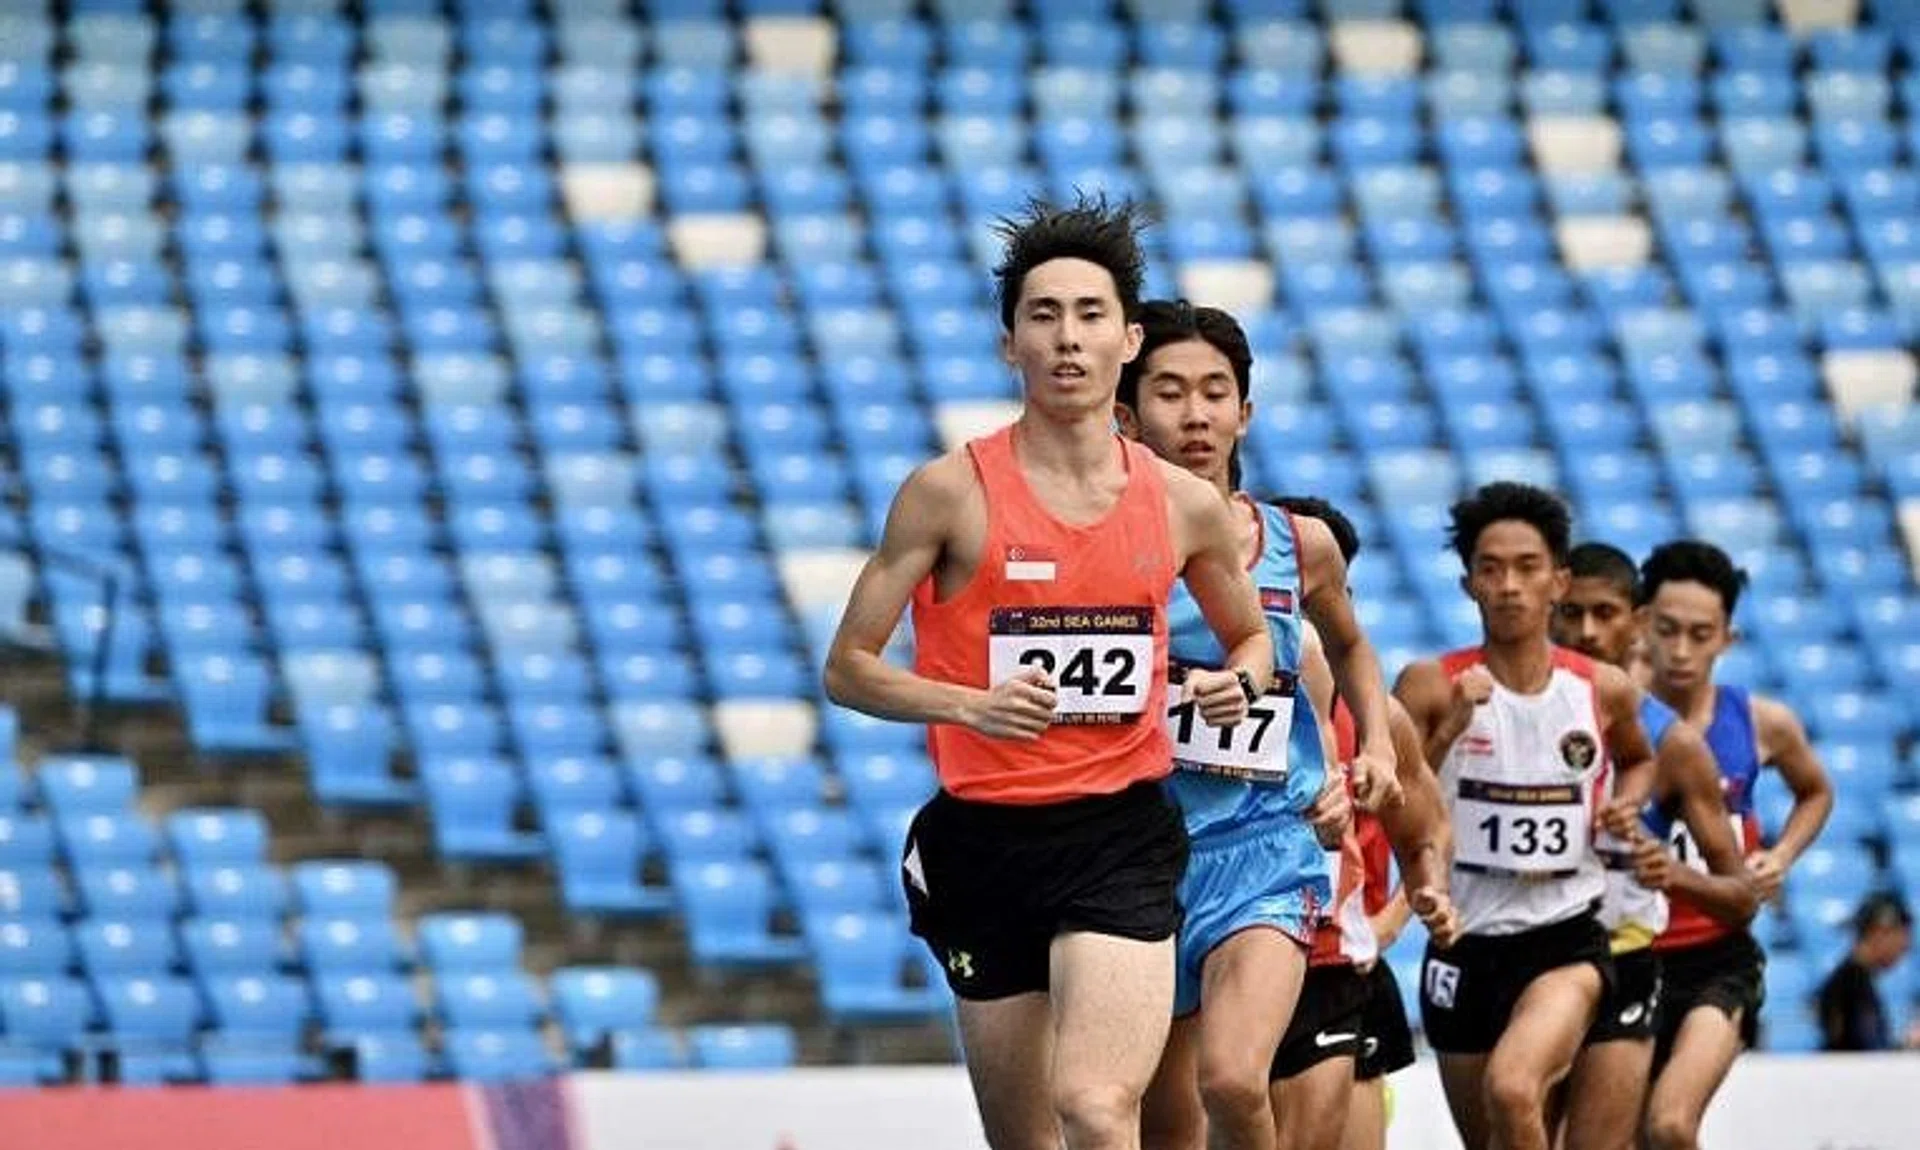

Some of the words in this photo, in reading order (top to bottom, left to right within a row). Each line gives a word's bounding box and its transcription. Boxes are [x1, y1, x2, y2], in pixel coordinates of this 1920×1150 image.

[1063, 615, 1091, 628] SEA
[1093, 615, 1138, 628] GAMES
[1479, 813, 1568, 856] 133
